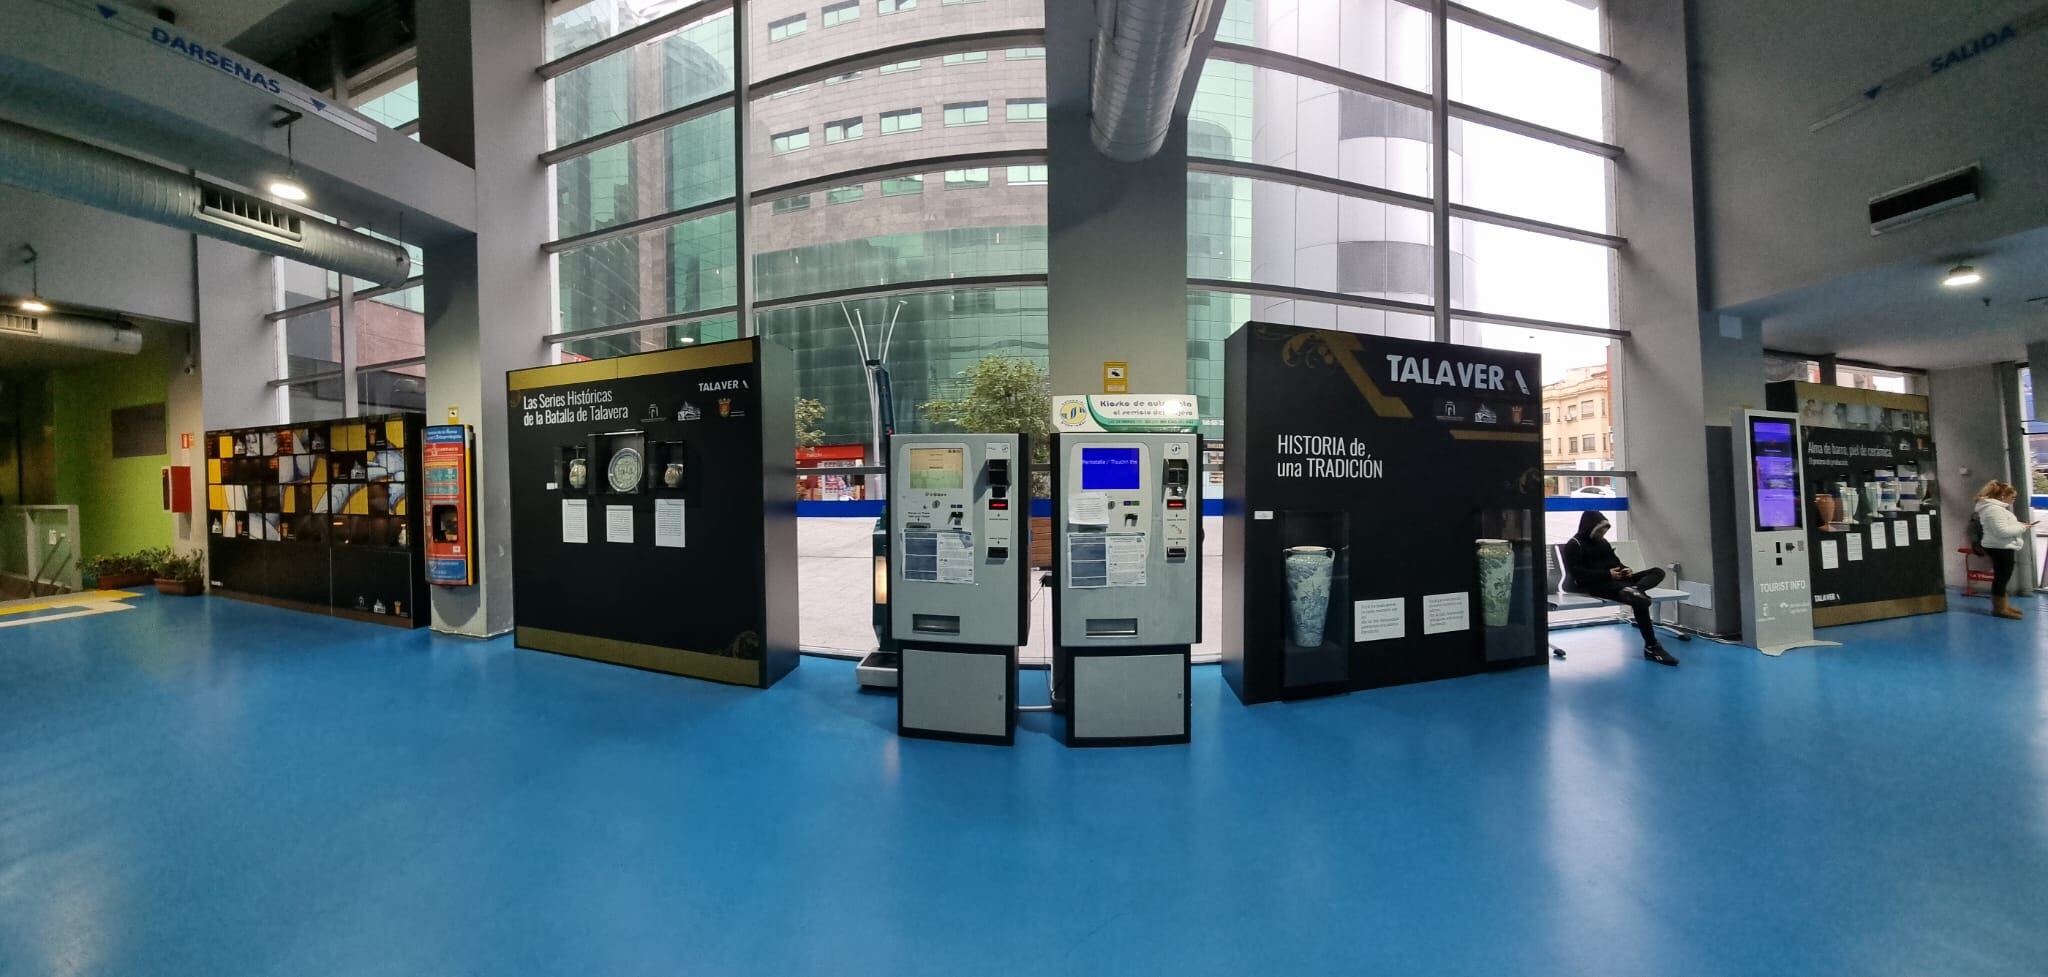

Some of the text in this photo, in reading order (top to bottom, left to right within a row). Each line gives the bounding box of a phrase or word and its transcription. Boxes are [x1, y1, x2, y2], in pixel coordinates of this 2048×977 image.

[1930, 24, 2017, 73] SALIDA
[151, 27, 281, 94] DARSENAS
[523, 388, 613, 410] Las Series Históricas
[523, 404, 629, 426] de la Batalla de Talavera
[1278, 434, 1366, 457] HISTORIA de
[1277, 453, 1383, 479] una TRADICIÓN
[1760, 580, 1806, 593] TOURIST INFO
